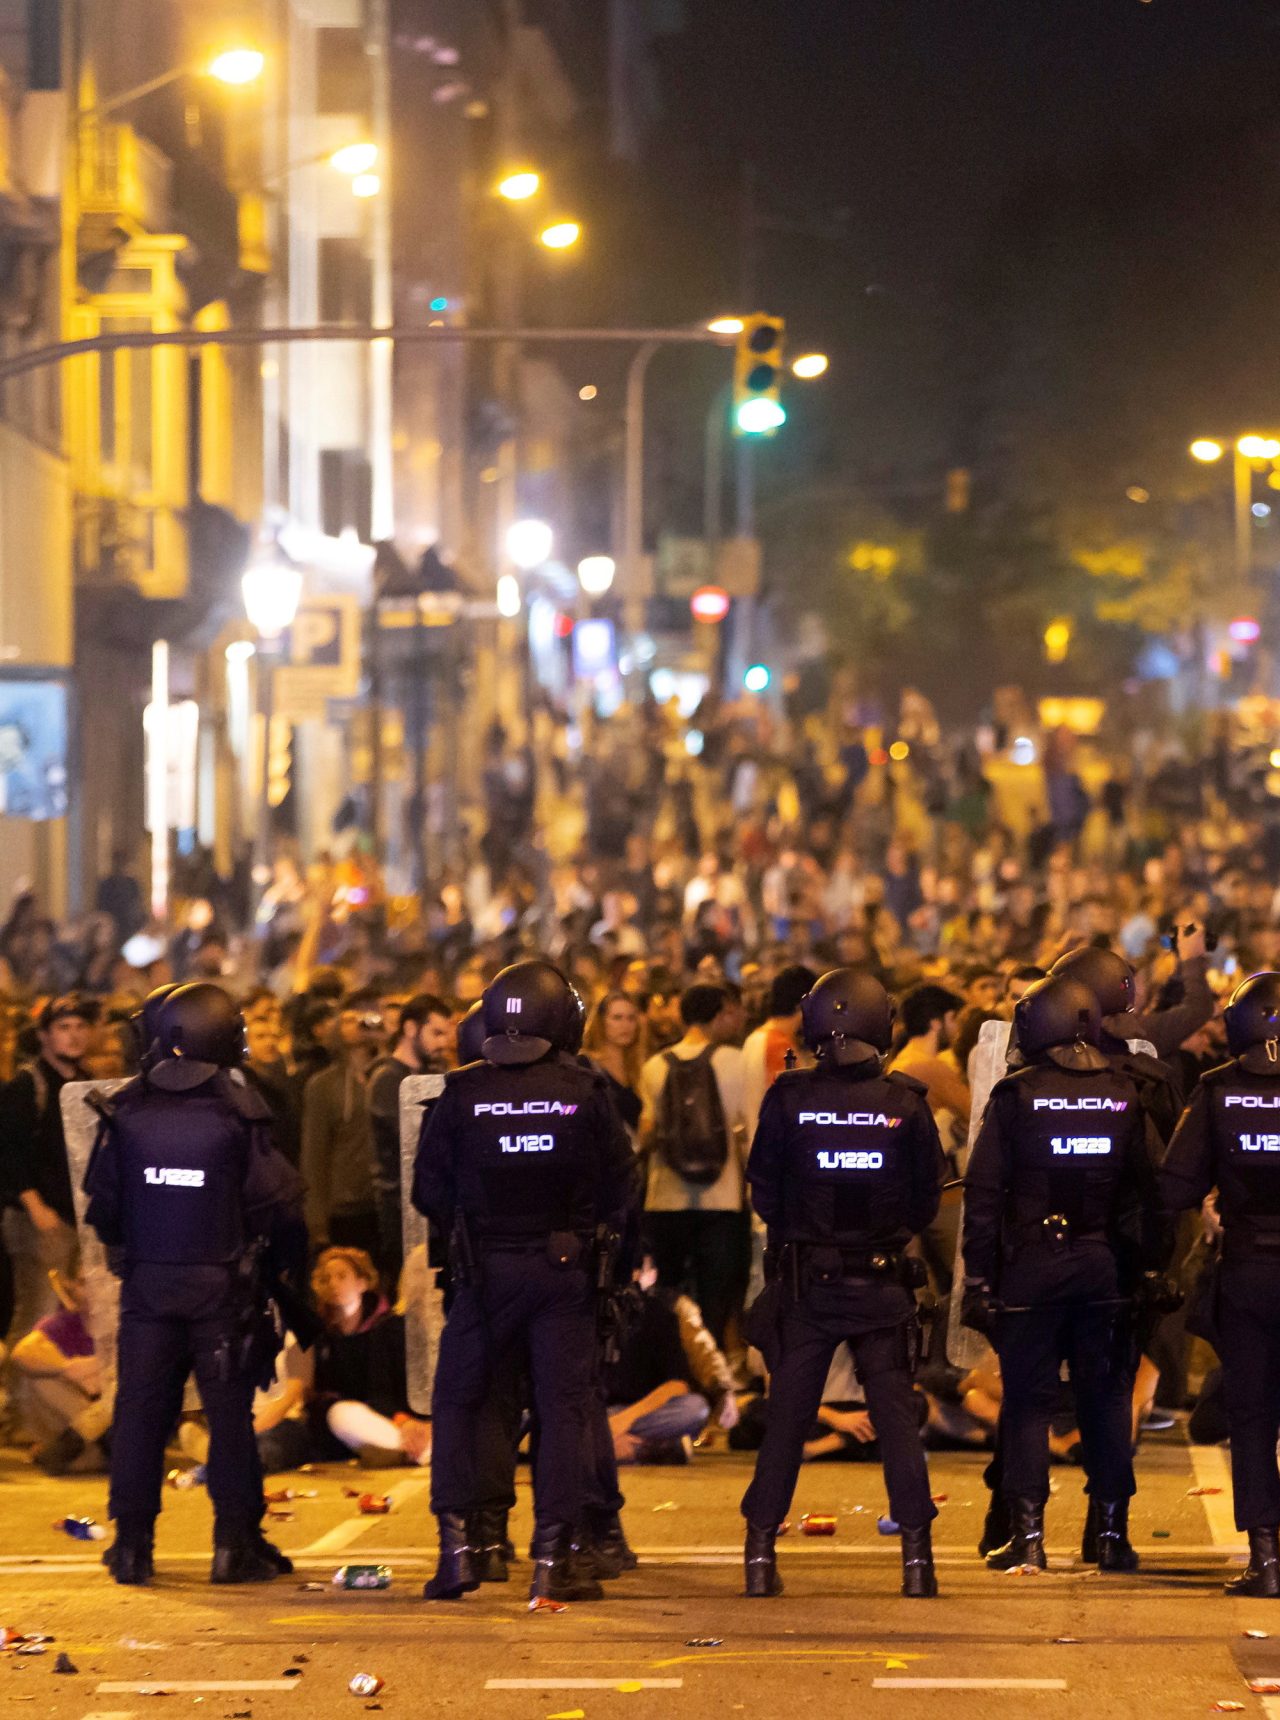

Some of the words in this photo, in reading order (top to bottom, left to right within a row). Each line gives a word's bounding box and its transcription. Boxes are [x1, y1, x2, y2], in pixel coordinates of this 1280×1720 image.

[474, 1101, 564, 1116] POLICIA
[1033, 1098, 1115, 1111] POLICIA
[799, 1112, 889, 1126] POLICIA
[498, 1134, 555, 1153] 1U120
[816, 1151, 883, 1169] 1U1220
